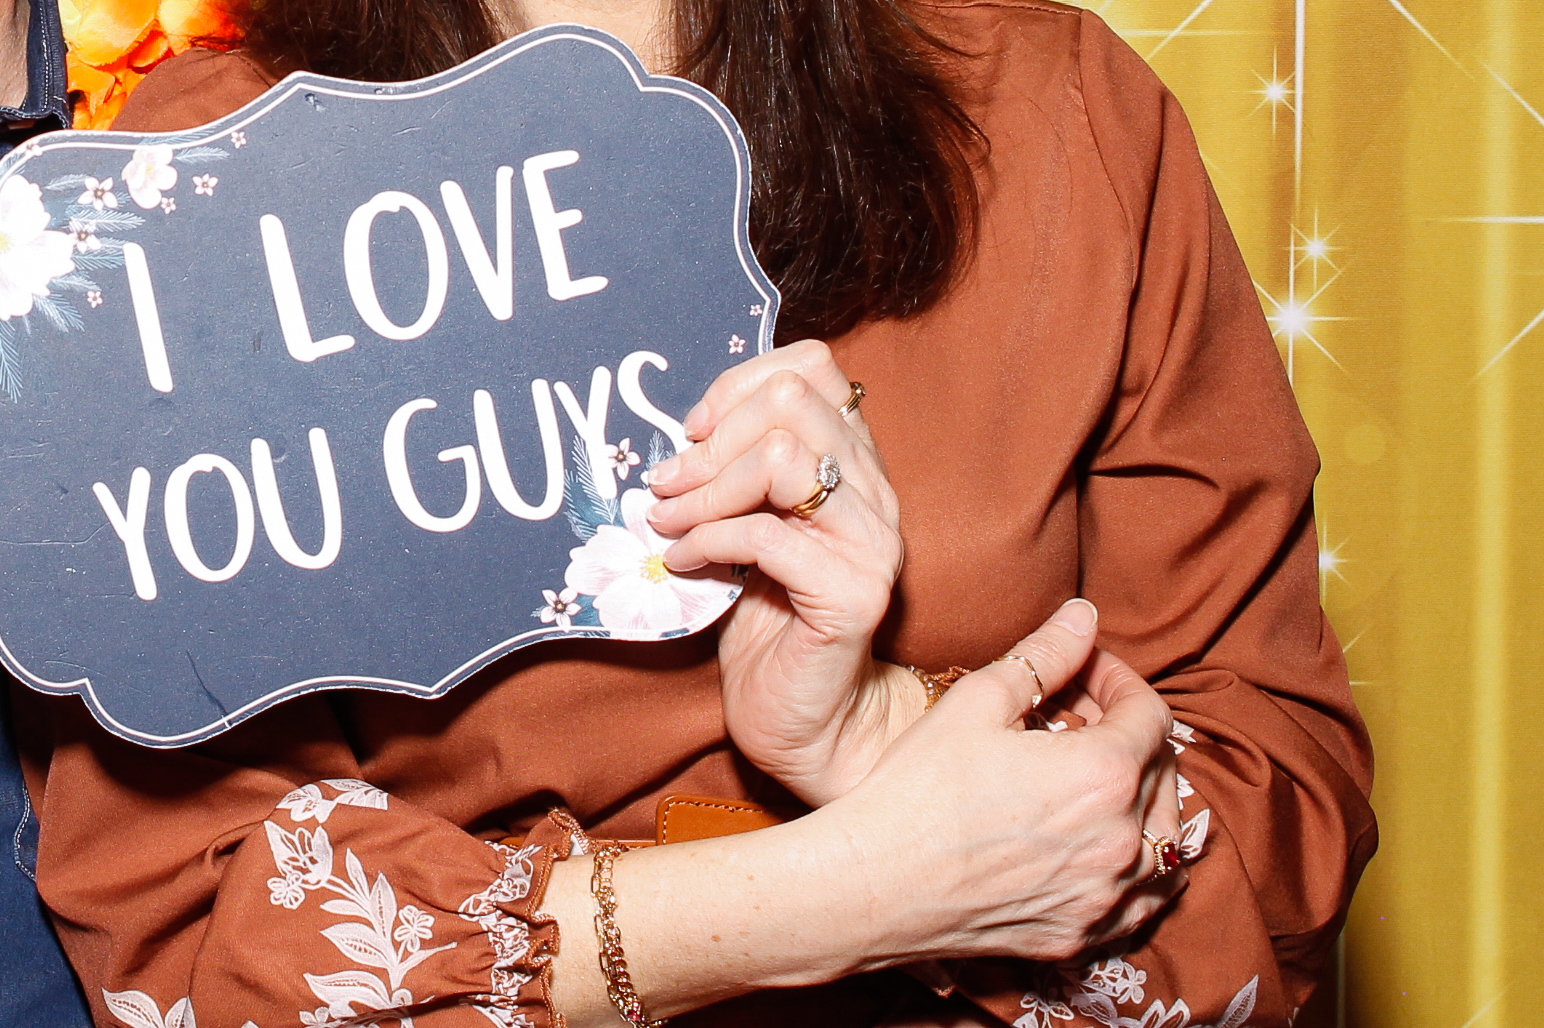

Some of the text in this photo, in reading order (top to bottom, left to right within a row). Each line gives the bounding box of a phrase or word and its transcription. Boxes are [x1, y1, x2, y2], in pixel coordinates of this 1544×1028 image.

[122, 149, 609, 393] I LOVE
[91, 350, 694, 602] YOU GUYS
